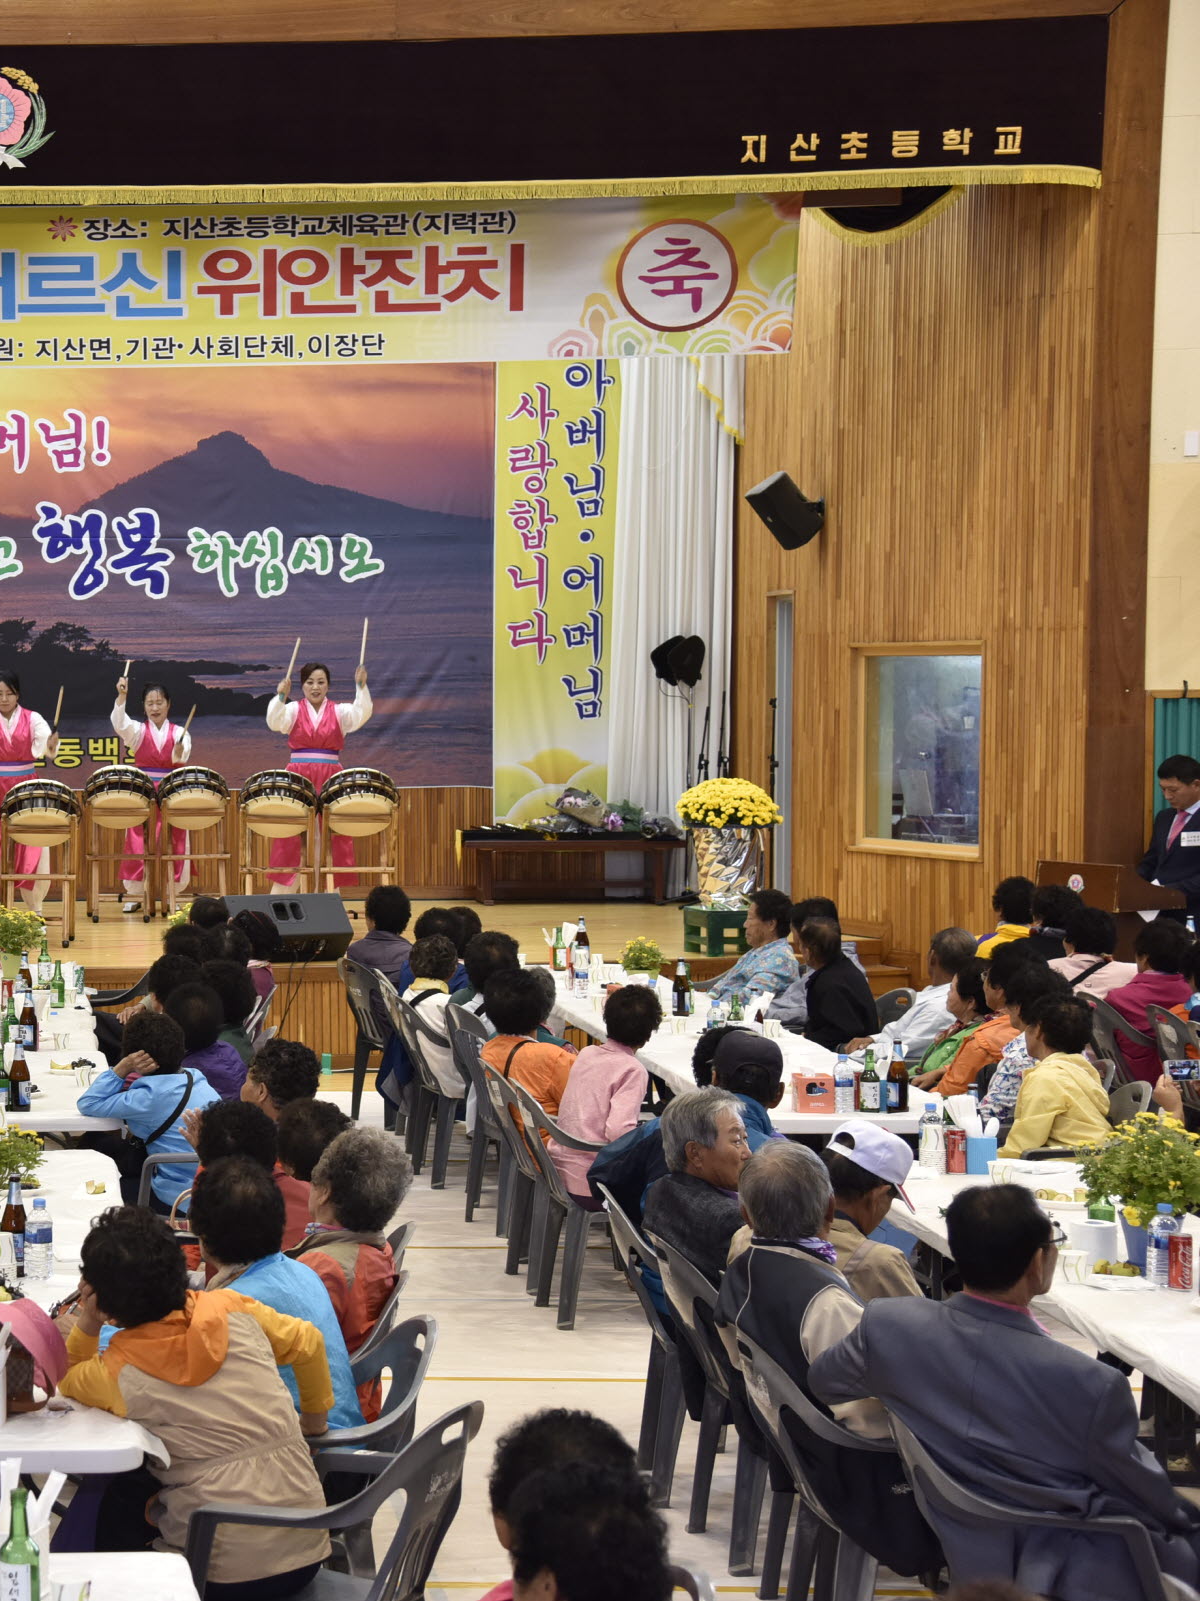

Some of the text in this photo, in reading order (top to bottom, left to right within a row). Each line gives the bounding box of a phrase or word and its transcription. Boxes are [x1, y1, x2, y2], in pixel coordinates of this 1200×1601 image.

[740, 126, 1022, 163] 지산초등학교
[82, 211, 517, 241] 장소: 지산초등학교체육관(지력관)
[198, 243, 526, 317] 위안잔치
[638, 235, 721, 313] 축
[35, 501, 174, 598] 행복
[188, 528, 384, 598] 하십시오
[506, 382, 559, 665] 사랑합니다
